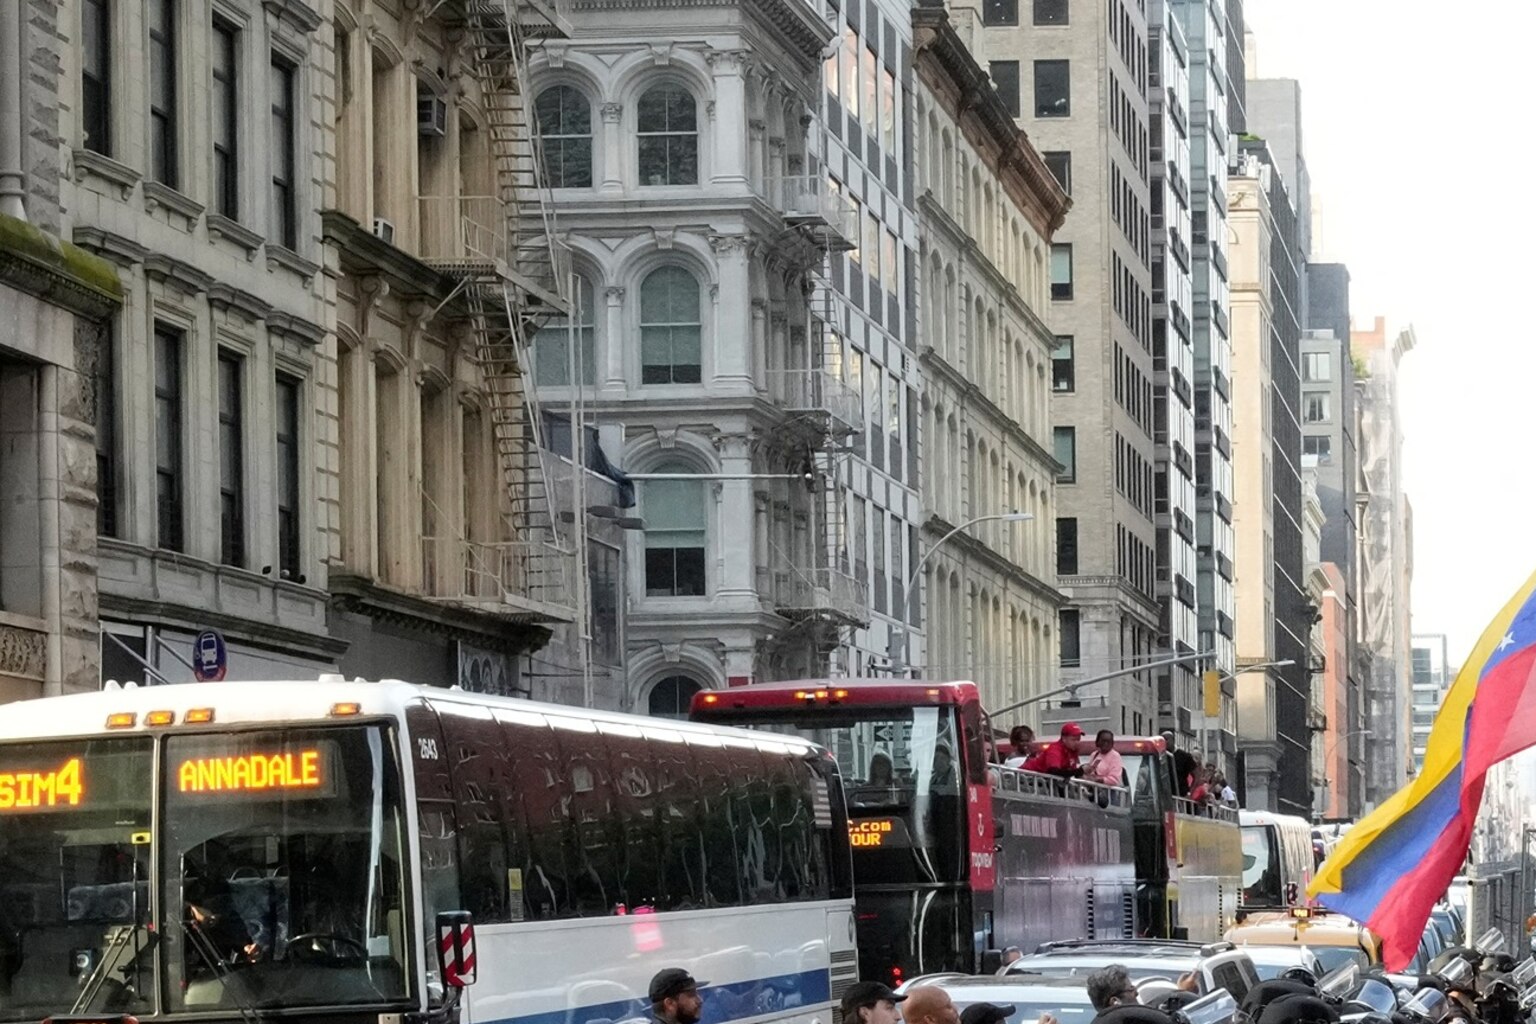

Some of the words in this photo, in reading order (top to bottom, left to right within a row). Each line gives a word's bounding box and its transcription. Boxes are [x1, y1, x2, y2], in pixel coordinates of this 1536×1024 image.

[0, 758, 82, 807] SIM4
[179, 752, 320, 792] ANNADALE
[849, 832, 882, 846] OUR
